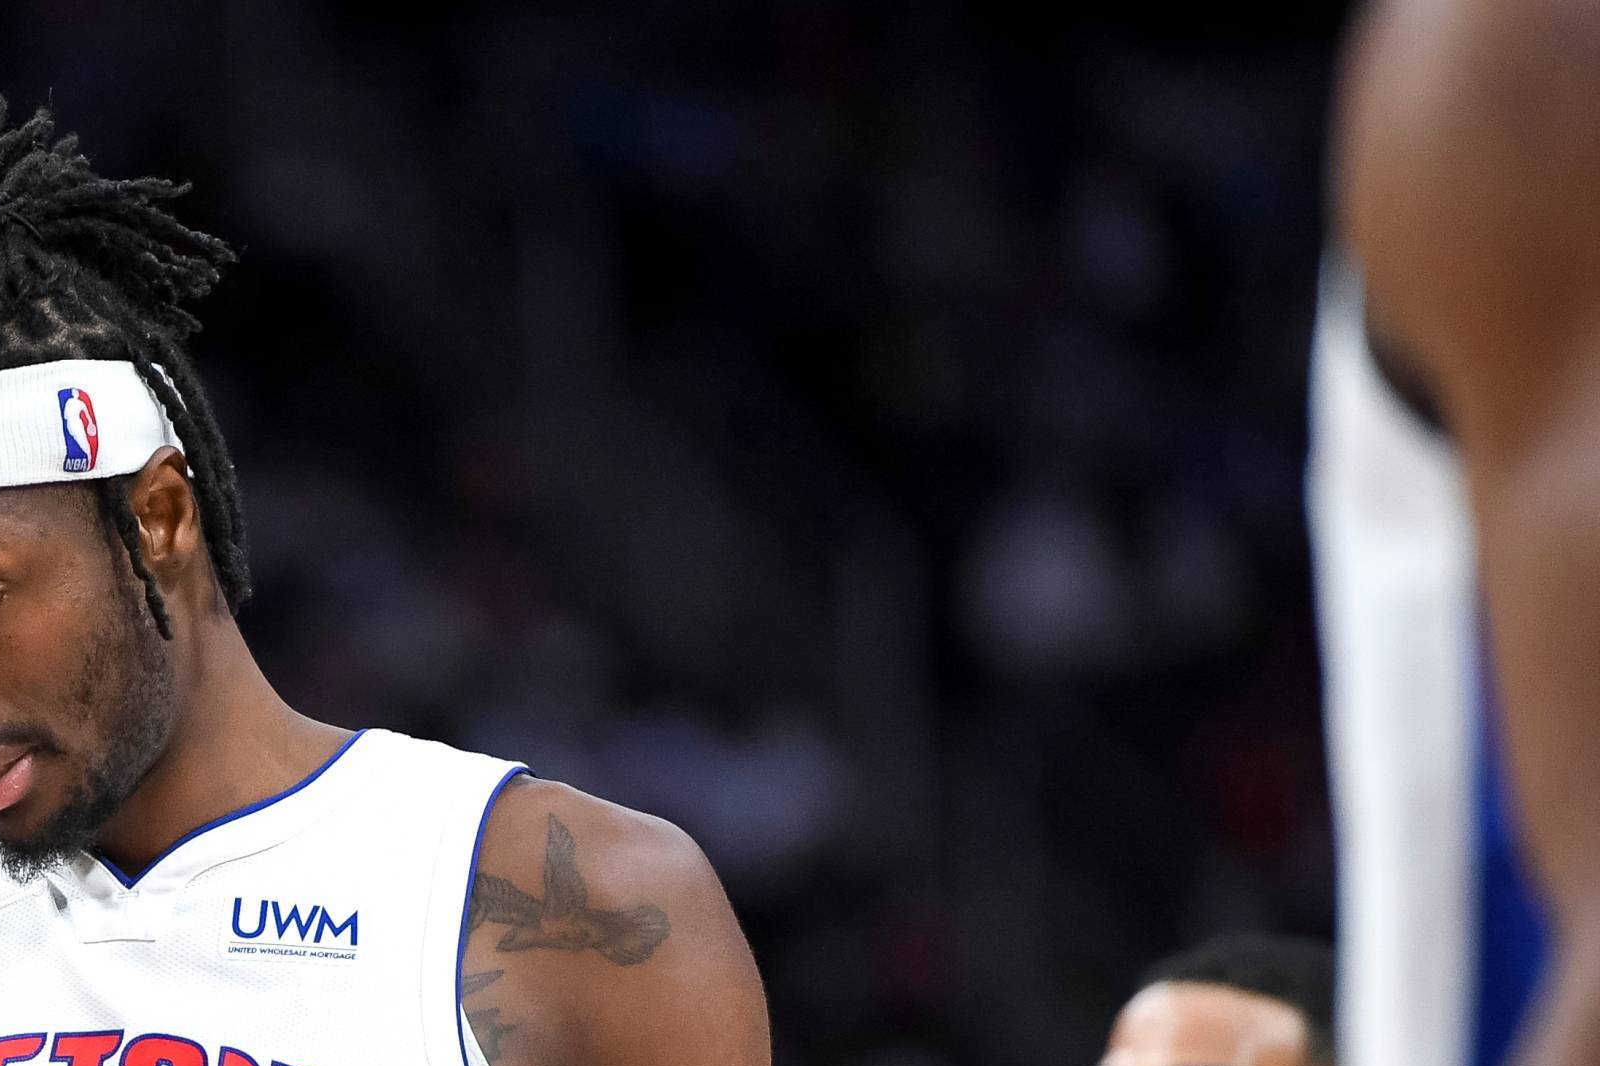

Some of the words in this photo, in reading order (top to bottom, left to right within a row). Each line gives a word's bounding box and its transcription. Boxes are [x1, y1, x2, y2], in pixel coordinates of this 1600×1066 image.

[65, 458, 88, 471] NBA
[232, 897, 358, 946] UWM
[228, 946, 257, 954] UNITED
[260, 947, 307, 957] WHOLESALE
[310, 951, 356, 960] MORTGAGE
